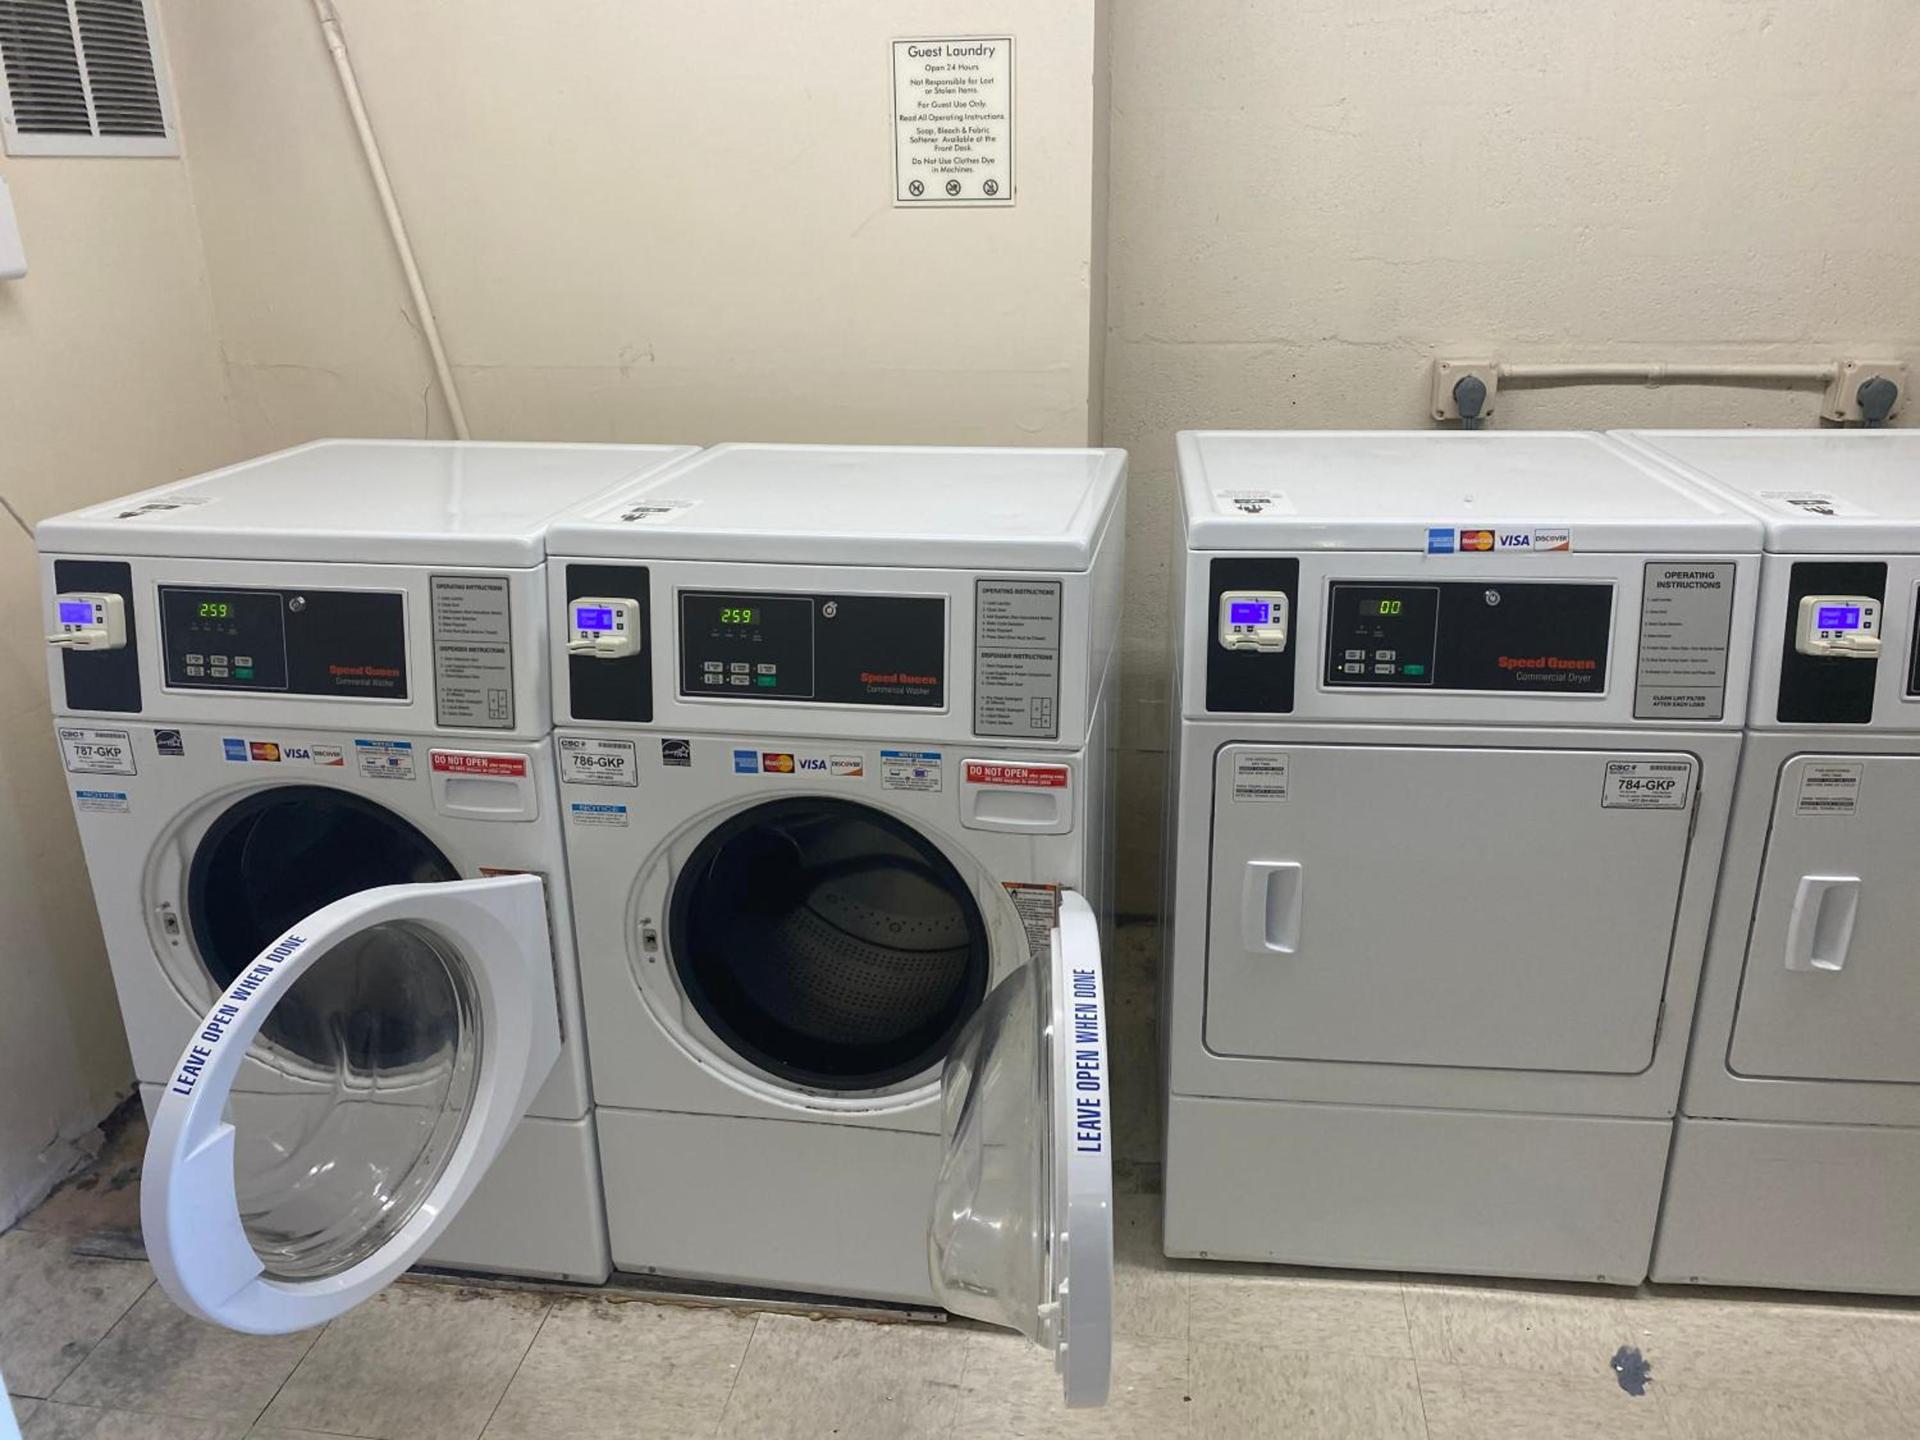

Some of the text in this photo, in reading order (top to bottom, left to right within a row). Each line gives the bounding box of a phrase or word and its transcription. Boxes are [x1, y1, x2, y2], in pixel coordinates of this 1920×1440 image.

[908, 43, 996, 59] Guest Laundry
[924, 64, 945, 72] Open
[958, 63, 979, 71] Hours
[925, 78, 966, 87] Responsible
[980, 77, 994, 85] Lost
[953, 100, 967, 108] Use
[928, 113, 963, 122] Operating
[968, 126, 990, 134] Fabric
[912, 157, 922, 165] Do
[923, 157, 937, 165] Not
[981, 156, 996, 165] Dye
[1500, 535, 1531, 546] VISA
[1536, 535, 1567, 543] DISCOVER
[1664, 571, 1715, 580] OPERATING
[1656, 581, 1721, 589] INSTRUCTIONS
[199, 603, 228, 617] 259
[721, 608, 752, 623] 259
[1498, 656, 1596, 670] Speed Queen
[329, 665, 400, 678] Speed Queen
[860, 672, 937, 685] Speed Queen
[1516, 671, 1592, 684] Commercial Dryer
[905, 687, 931, 696] Washer
[73, 745, 122, 757] 787-GKP
[283, 749, 311, 759] VISA
[434, 754, 446, 764] DO
[447, 756, 465, 766] NOT
[466, 757, 489, 767] OPEN
[572, 755, 625, 768] 786-GKP
[799, 759, 828, 770] VISA
[970, 766, 983, 775] DO
[984, 767, 1002, 777] NOT
[1004, 768, 1029, 778] OPEN
[1618, 780, 1676, 791] 784-GKP
[172, 934, 308, 1097] LEAVE OPEN WHEN DONE
[1073, 968, 1102, 1153] LEAVE OPEN WHEN DONE
